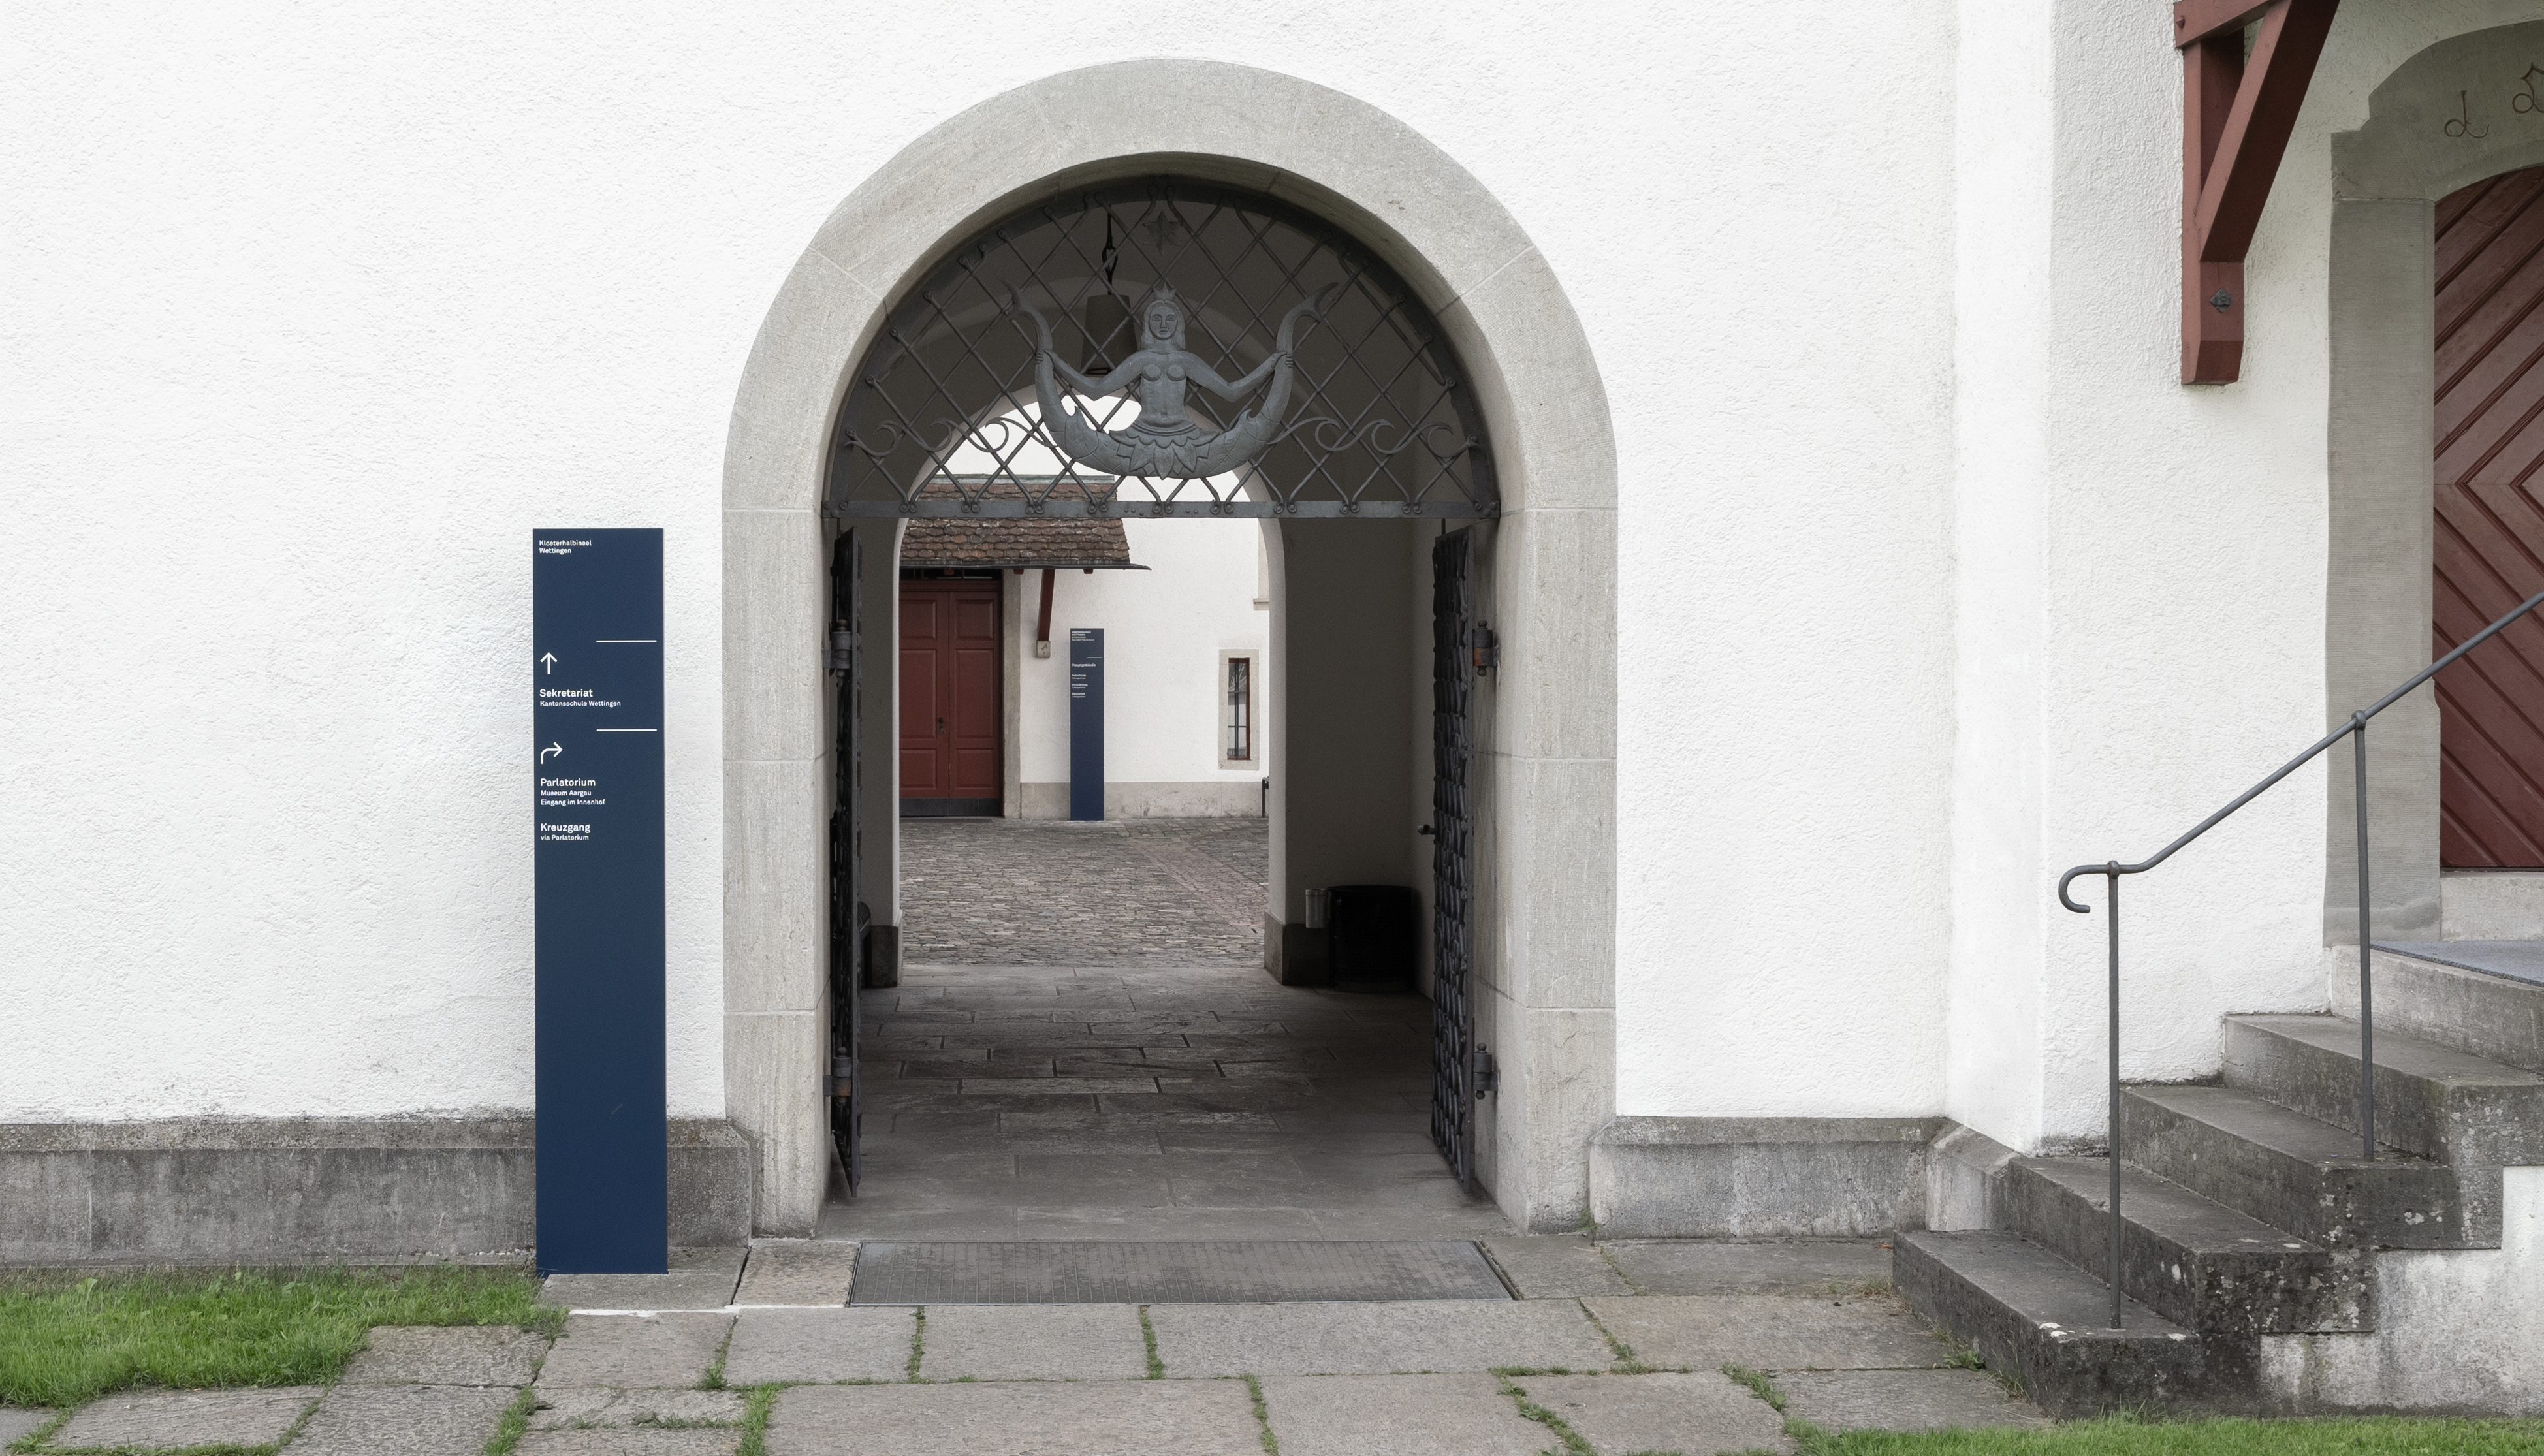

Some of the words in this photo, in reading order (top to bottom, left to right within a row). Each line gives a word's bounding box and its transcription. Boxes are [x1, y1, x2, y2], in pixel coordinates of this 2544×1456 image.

[539, 688, 594, 698] Sekretariat
[540, 778, 596, 787] Parlatorium
[569, 789, 592, 798] Aargau
[540, 799, 567, 807] Eingang
[540, 823, 591, 834] Kreuzgang
